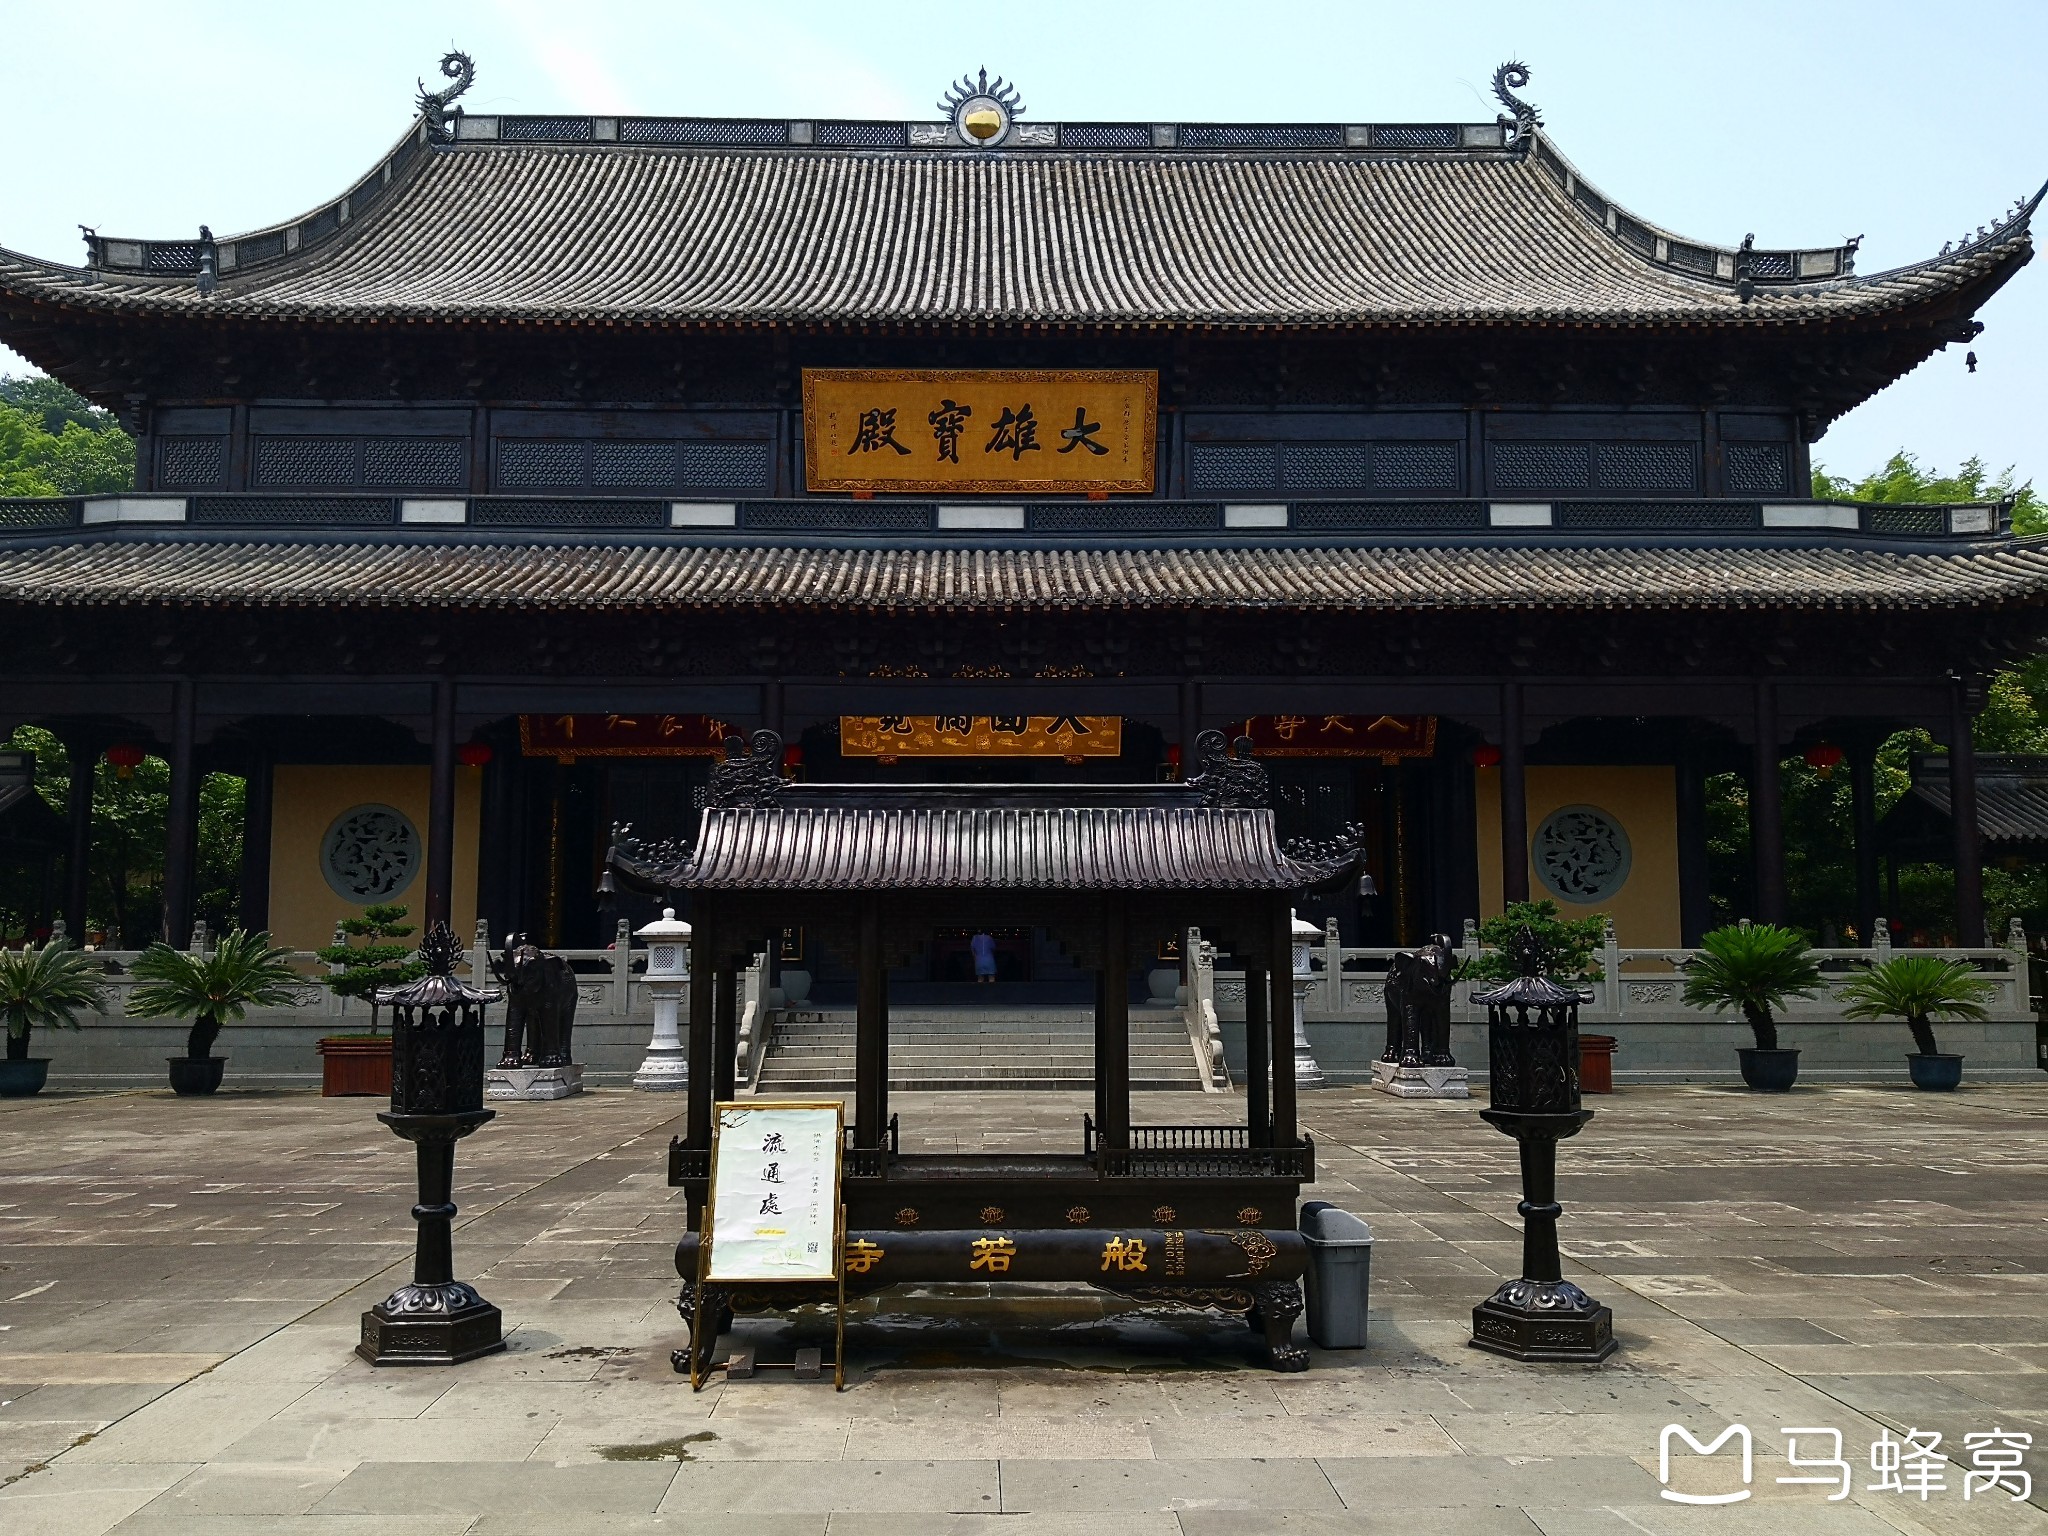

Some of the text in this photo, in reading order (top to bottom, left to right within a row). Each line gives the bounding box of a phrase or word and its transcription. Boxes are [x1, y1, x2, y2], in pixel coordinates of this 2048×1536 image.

[848, 399, 1110, 465] 大雄寶殿
[759, 1132, 788, 1215] 流通處
[845, 1236, 1148, 1273] 般若寺
